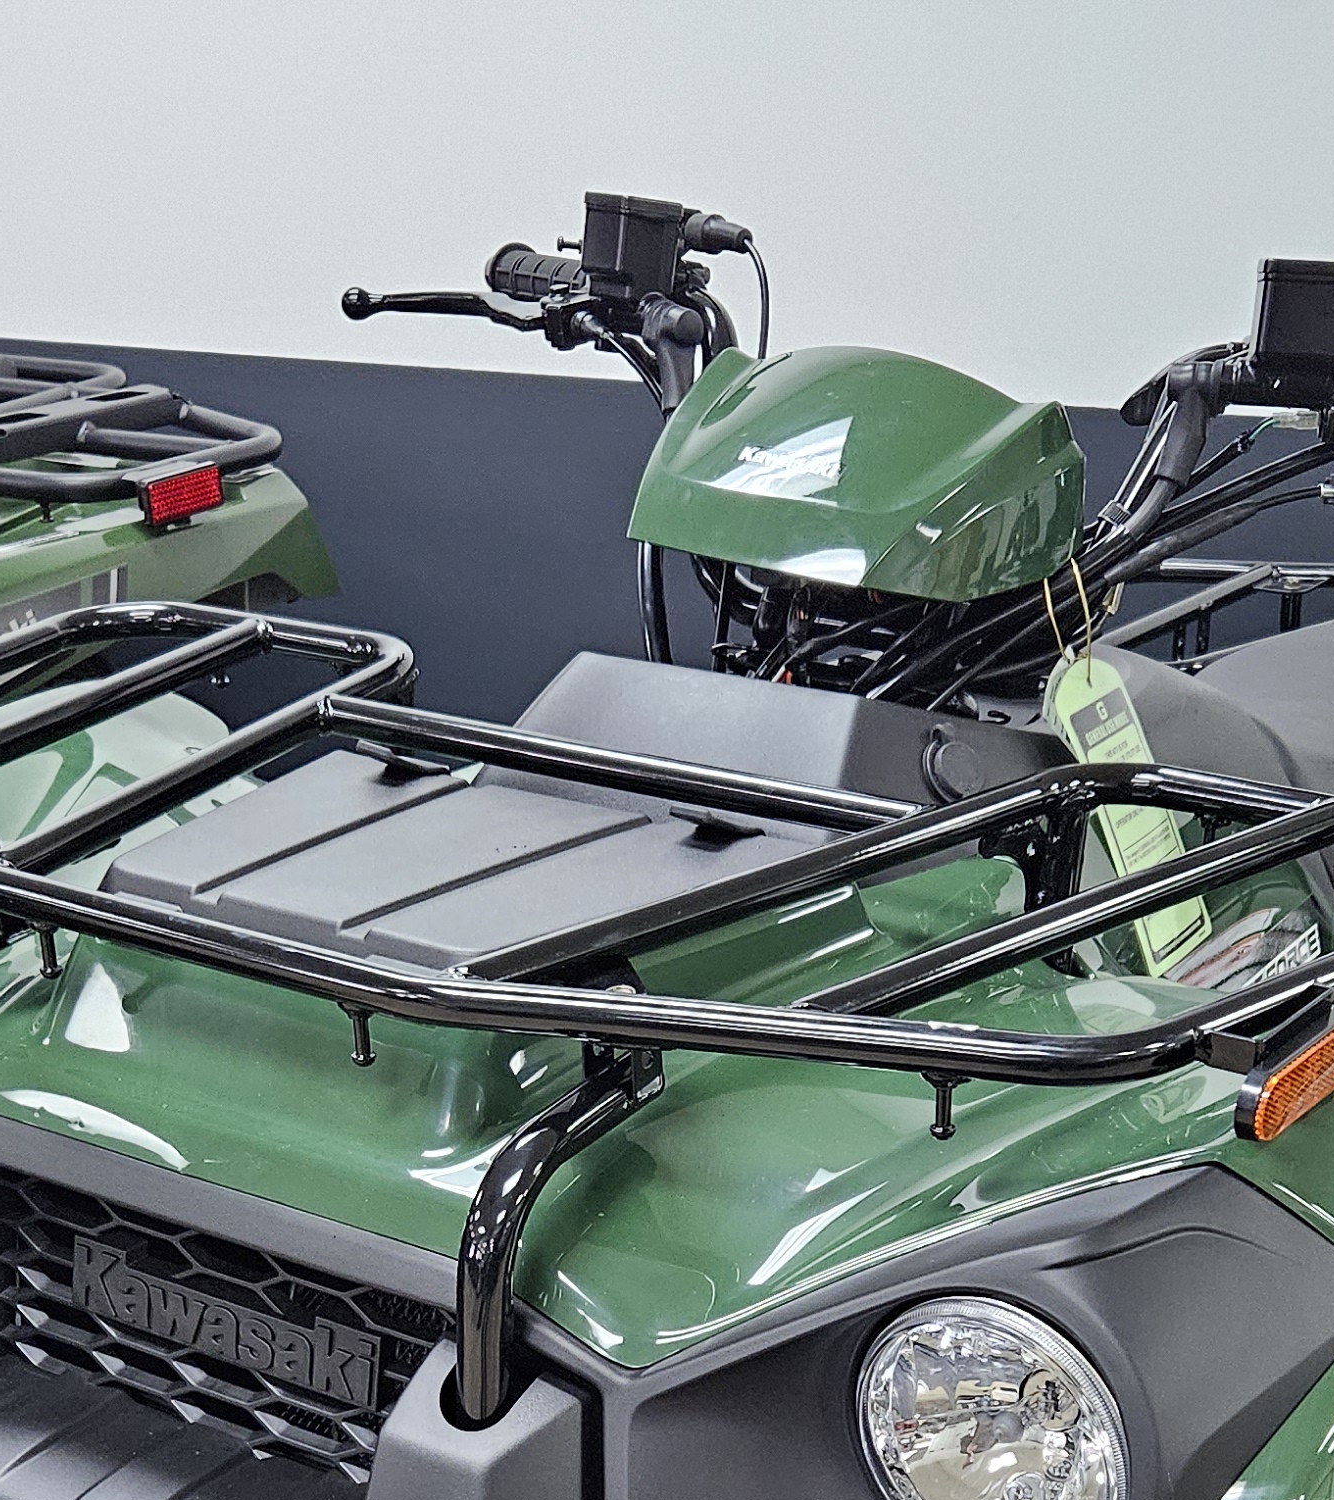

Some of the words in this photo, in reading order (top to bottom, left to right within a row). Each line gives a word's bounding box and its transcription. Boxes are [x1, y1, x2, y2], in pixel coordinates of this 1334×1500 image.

[736, 445, 841, 484] Kawasaki
[1095, 701, 1109, 721] G
[72, 1237, 380, 1410] Kawasaki
